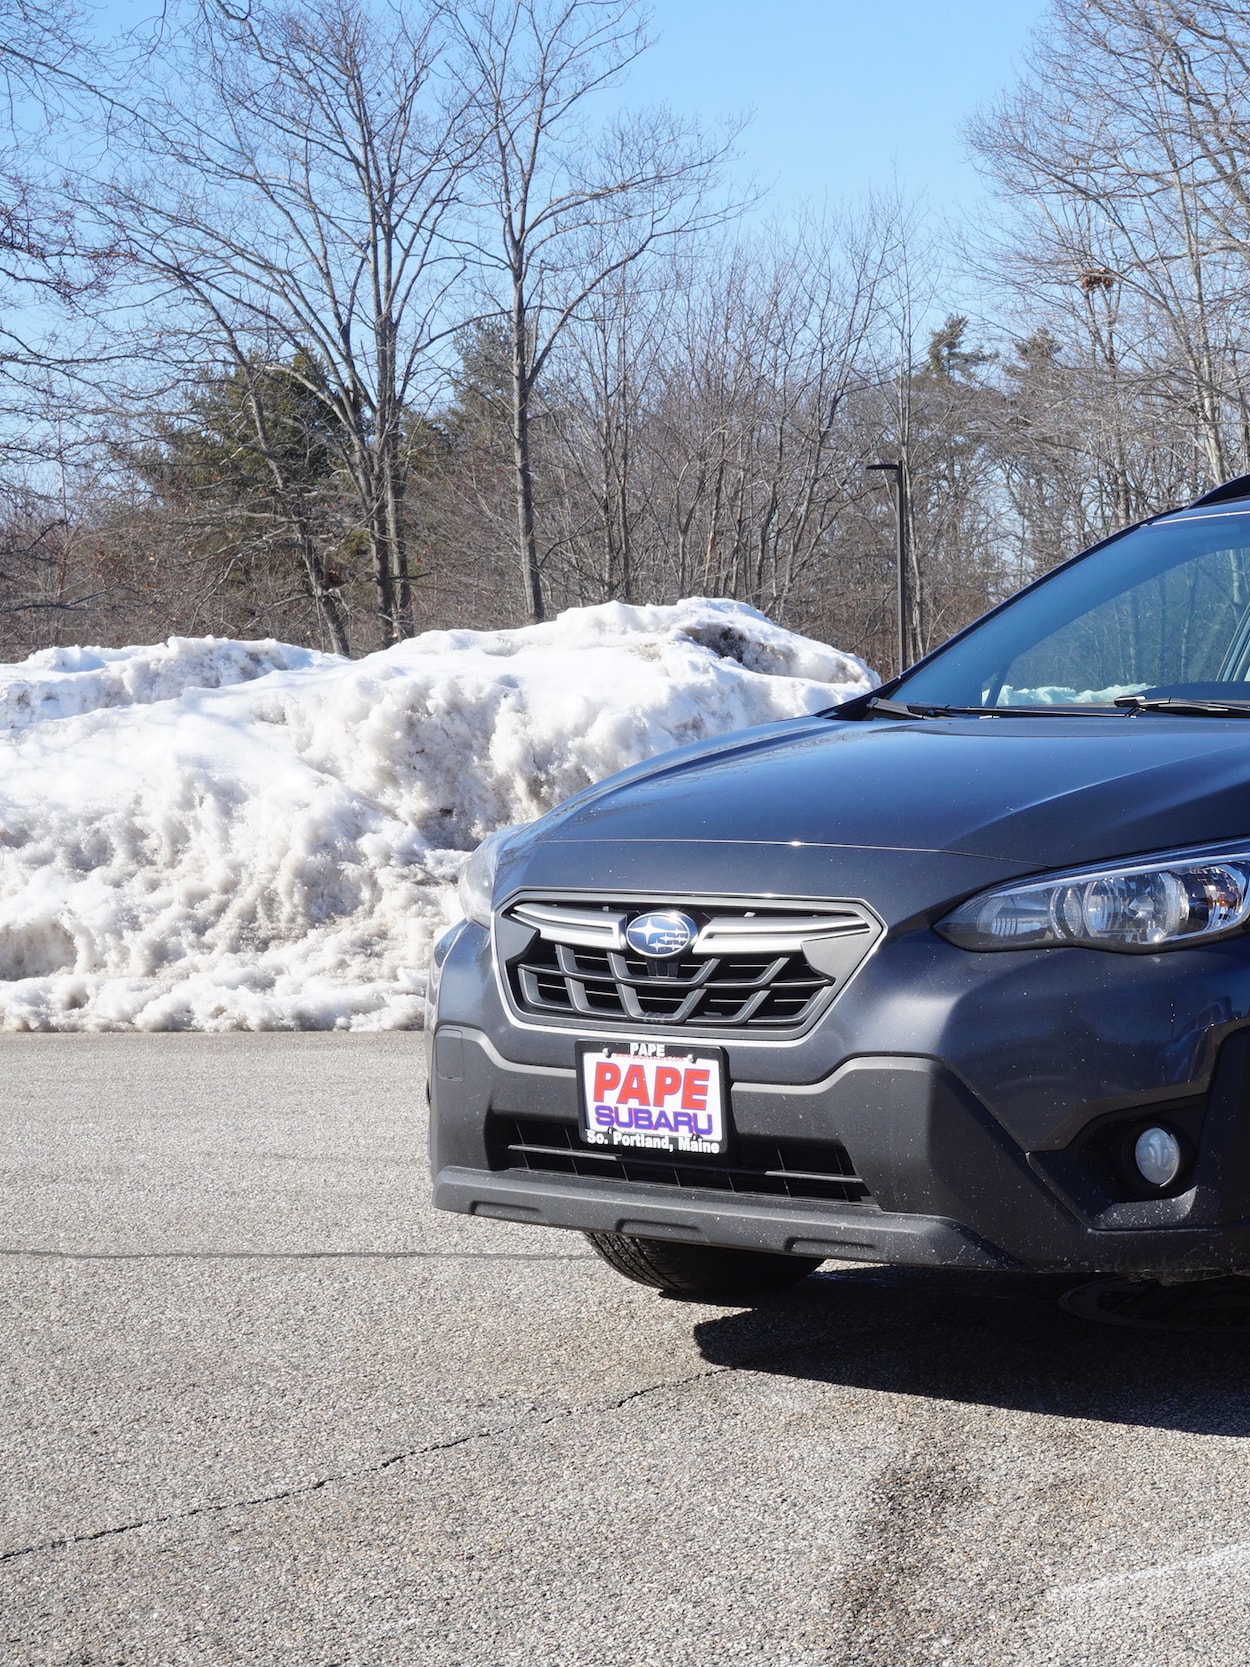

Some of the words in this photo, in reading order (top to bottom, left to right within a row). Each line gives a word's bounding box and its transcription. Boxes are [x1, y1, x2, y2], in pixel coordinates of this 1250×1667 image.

[630, 1043, 665, 1057] PAPE
[593, 1062, 710, 1111] PAPE
[595, 1105, 713, 1136] SUBARU
[586, 1130, 609, 1145] So.
[613, 1132, 674, 1152] Portland,
[678, 1136, 720, 1153] Maine
